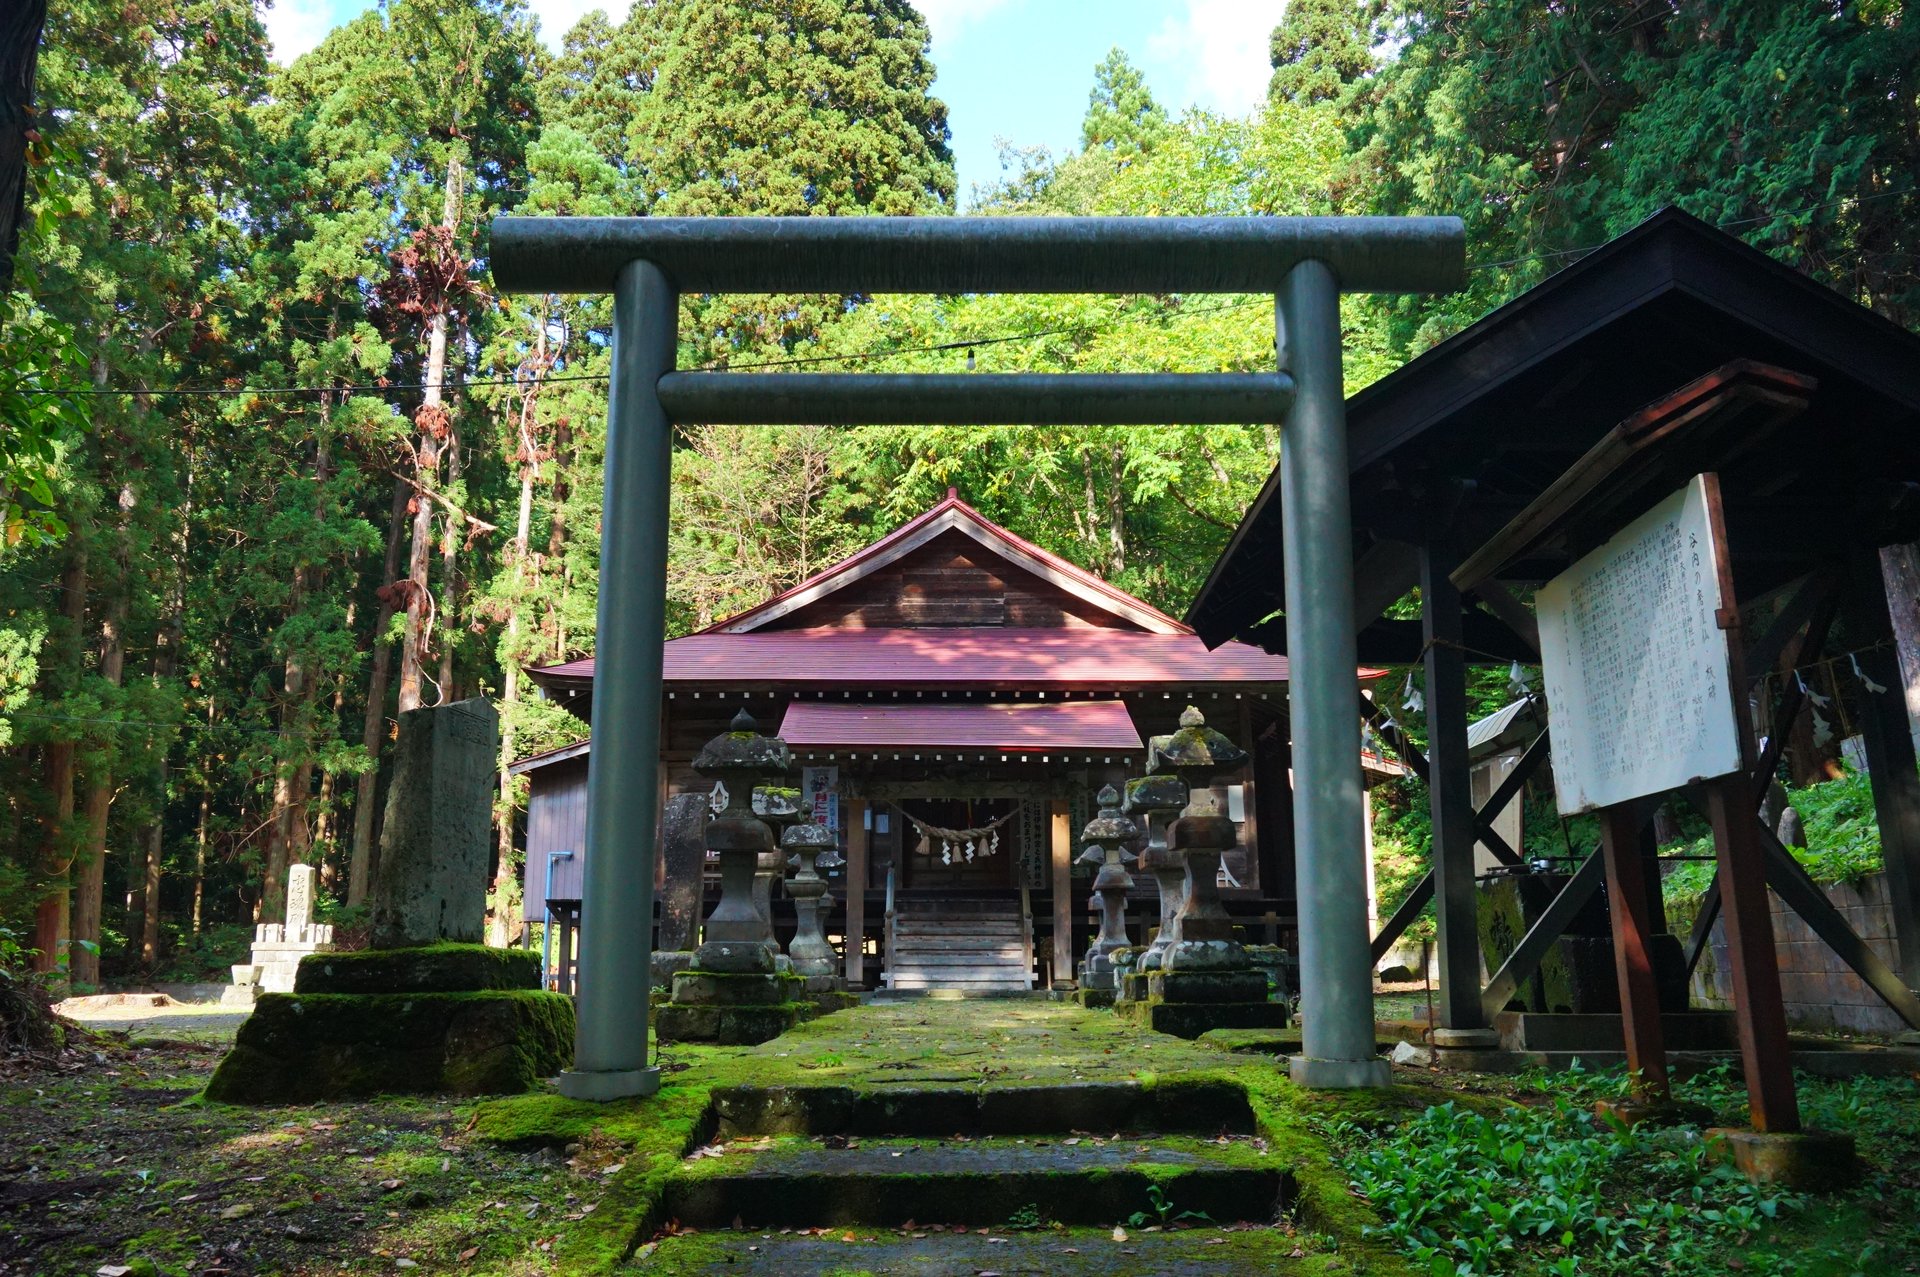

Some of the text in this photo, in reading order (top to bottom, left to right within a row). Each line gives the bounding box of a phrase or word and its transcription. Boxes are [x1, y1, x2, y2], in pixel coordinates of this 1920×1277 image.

[814, 793, 828, 826] 月に一度
[288, 874, 305, 925] 忠魂碑
